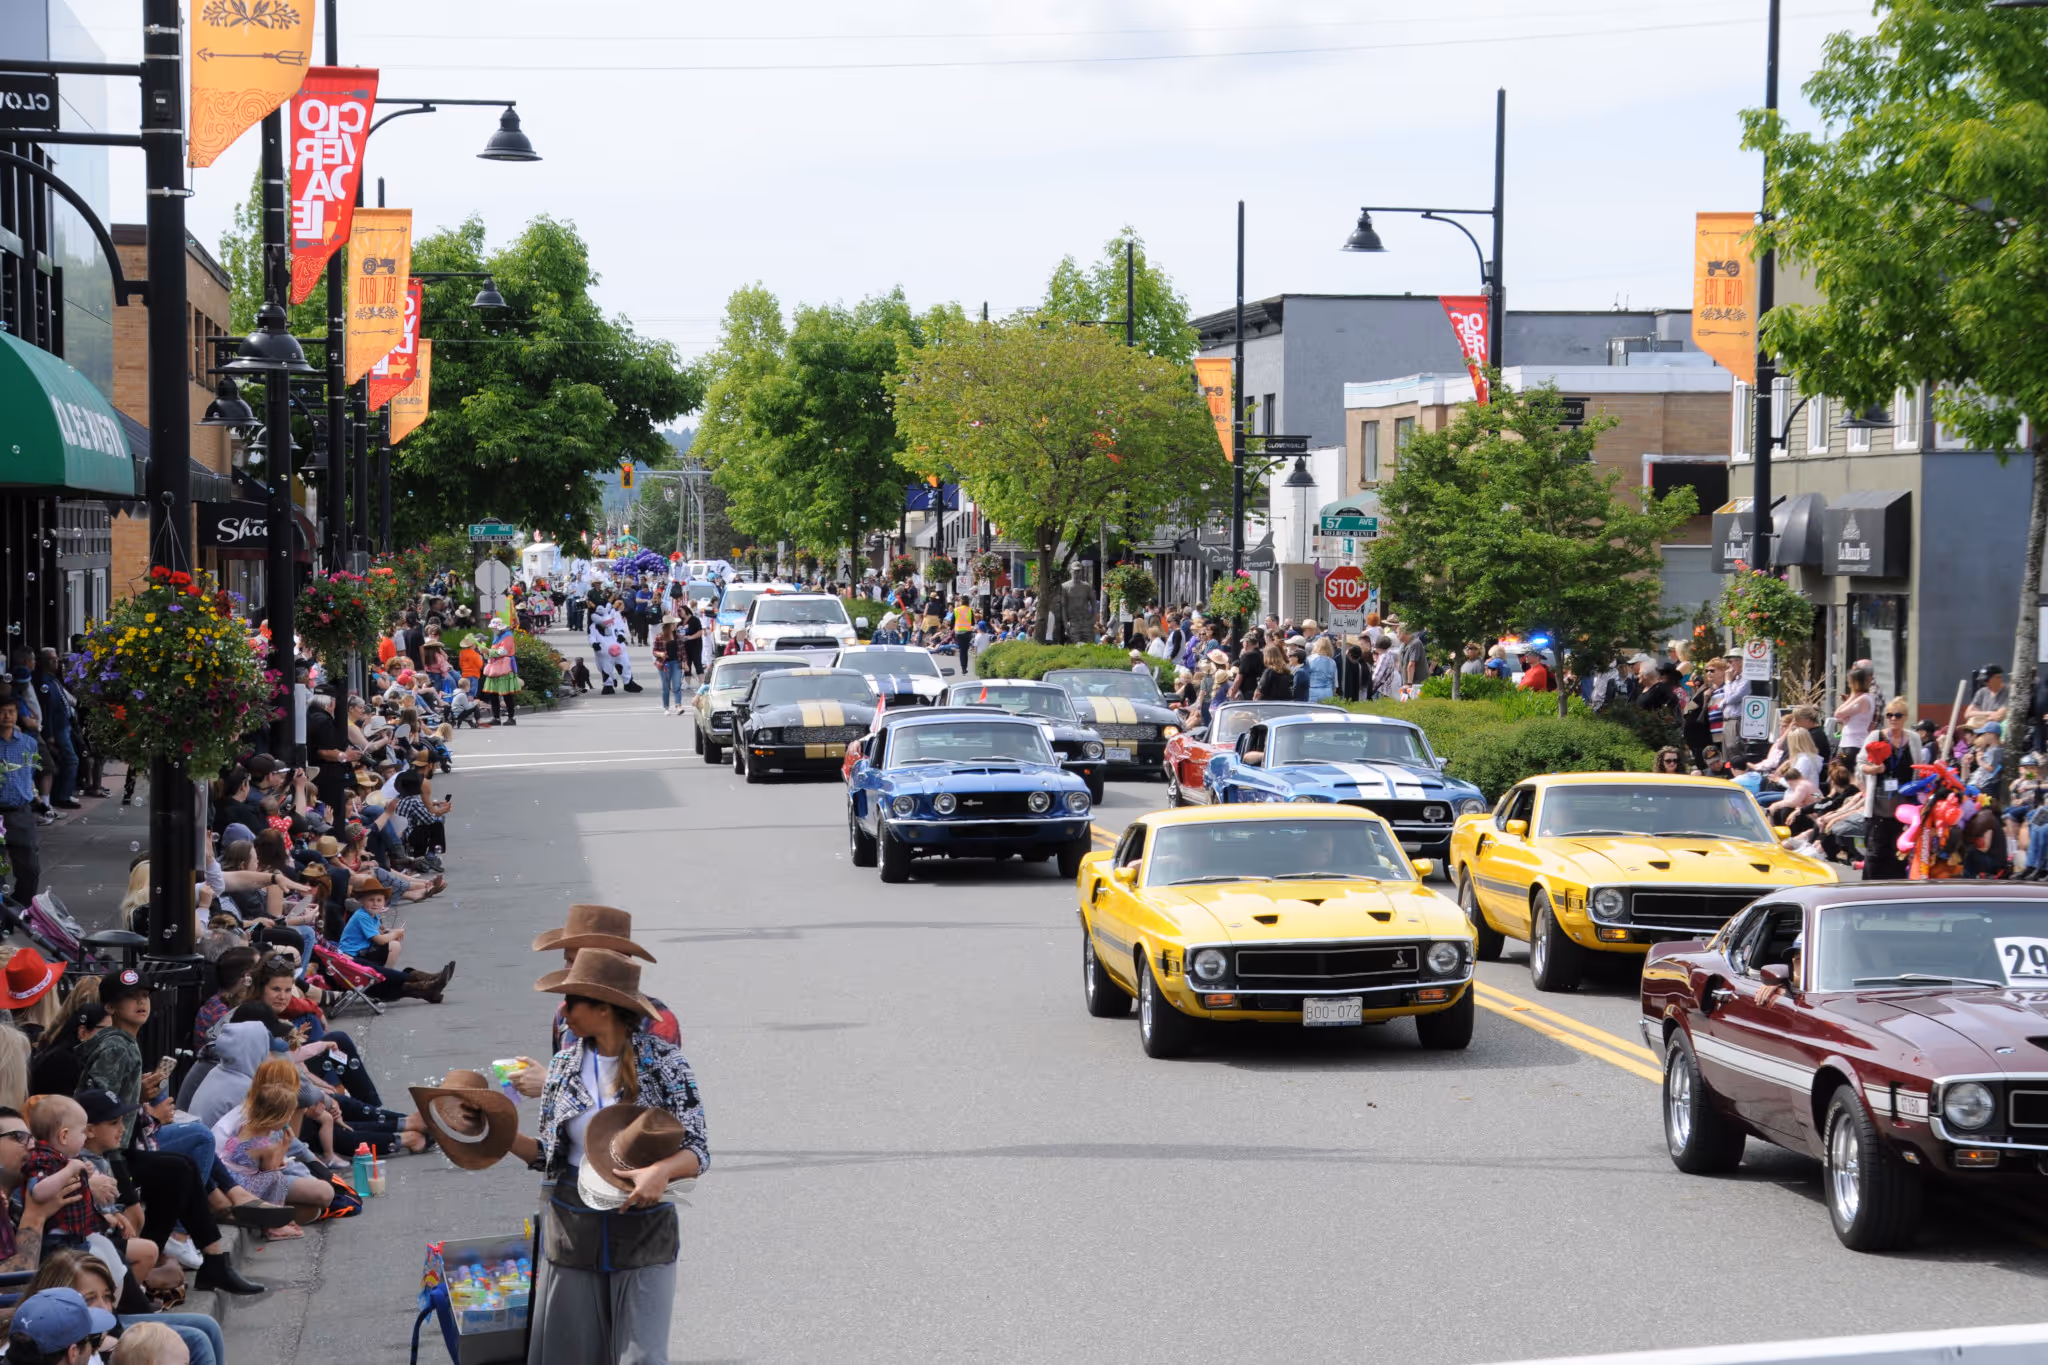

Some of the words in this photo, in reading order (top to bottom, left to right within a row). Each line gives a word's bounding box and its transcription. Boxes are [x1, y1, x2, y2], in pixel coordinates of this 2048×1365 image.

[1724, 278, 1743, 306] 1870
[1326, 517, 1342, 529] 57
[1358, 518, 1374, 526] AVE
[473, 526, 486, 535] 57
[1327, 578, 1367, 598] STOP
[1332, 618, 1359, 627] ALL-WAY
